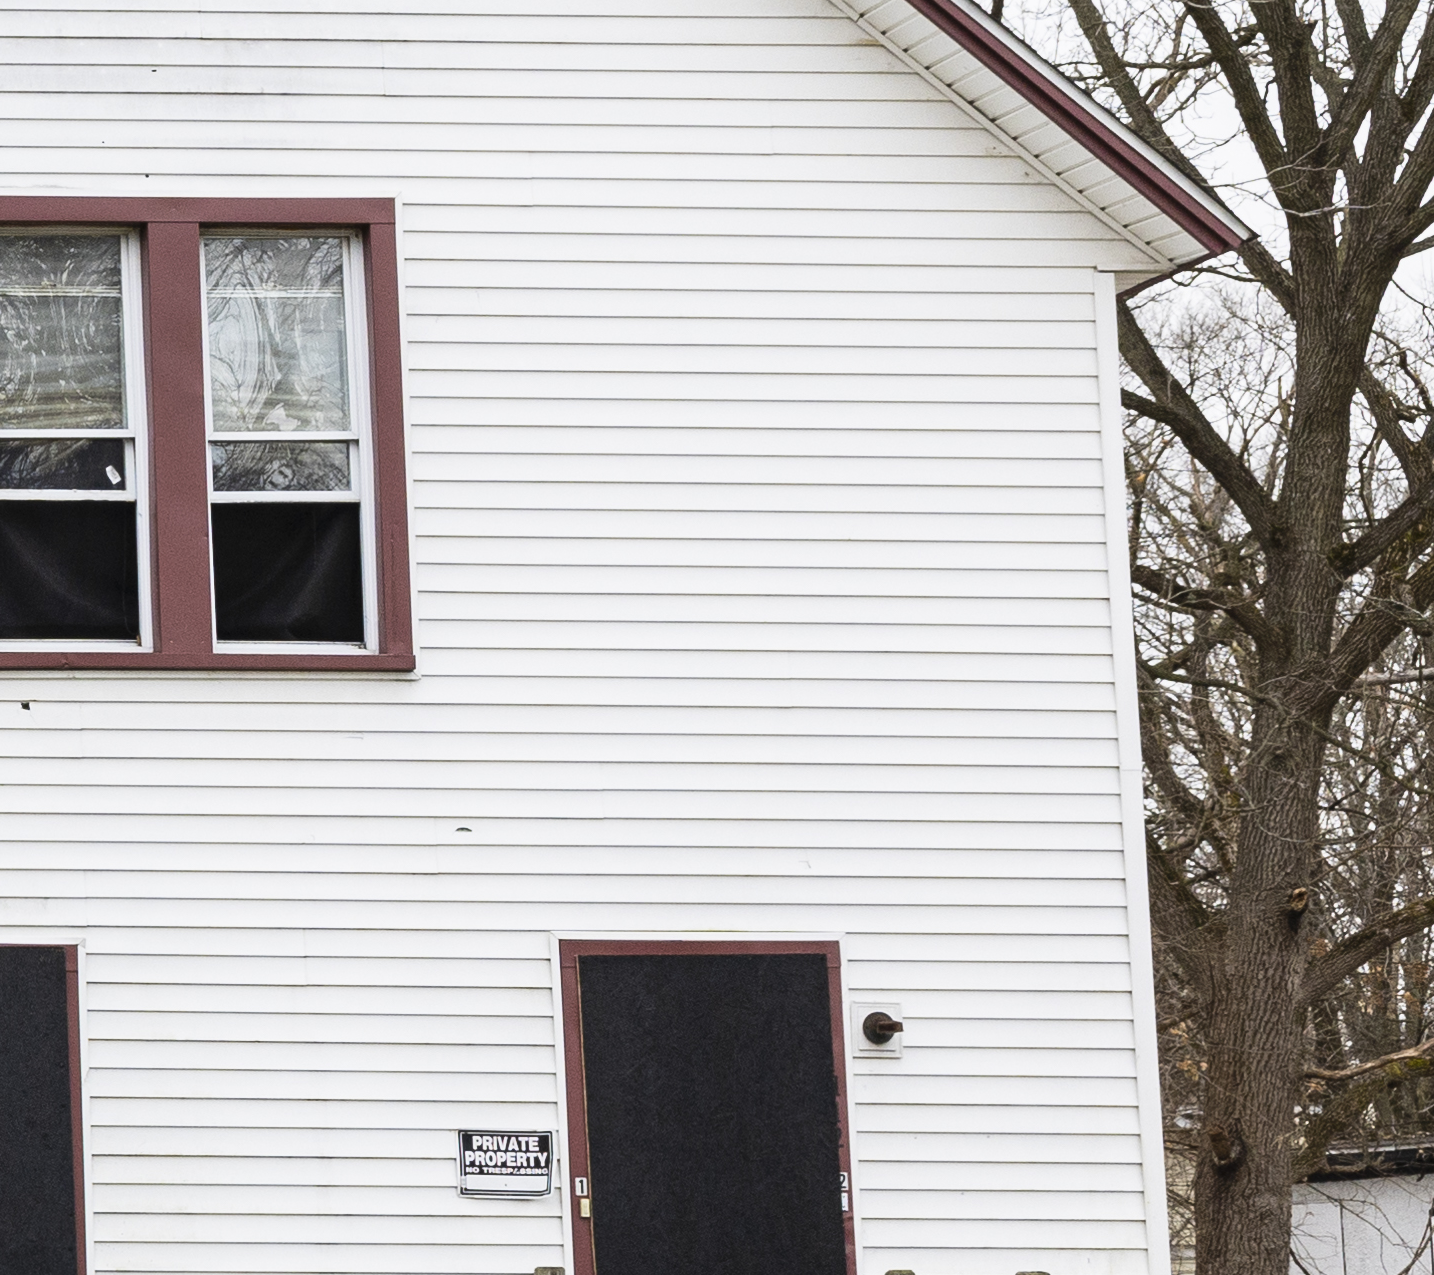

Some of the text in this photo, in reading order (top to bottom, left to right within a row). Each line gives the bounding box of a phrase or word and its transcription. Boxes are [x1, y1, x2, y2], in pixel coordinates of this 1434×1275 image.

[472, 1136, 540, 1152] PRIVATE
[465, 1151, 548, 1167] PROPERTY
[483, 1167, 549, 1175] TRESPASSING
[578, 1179, 585, 1194] 1
